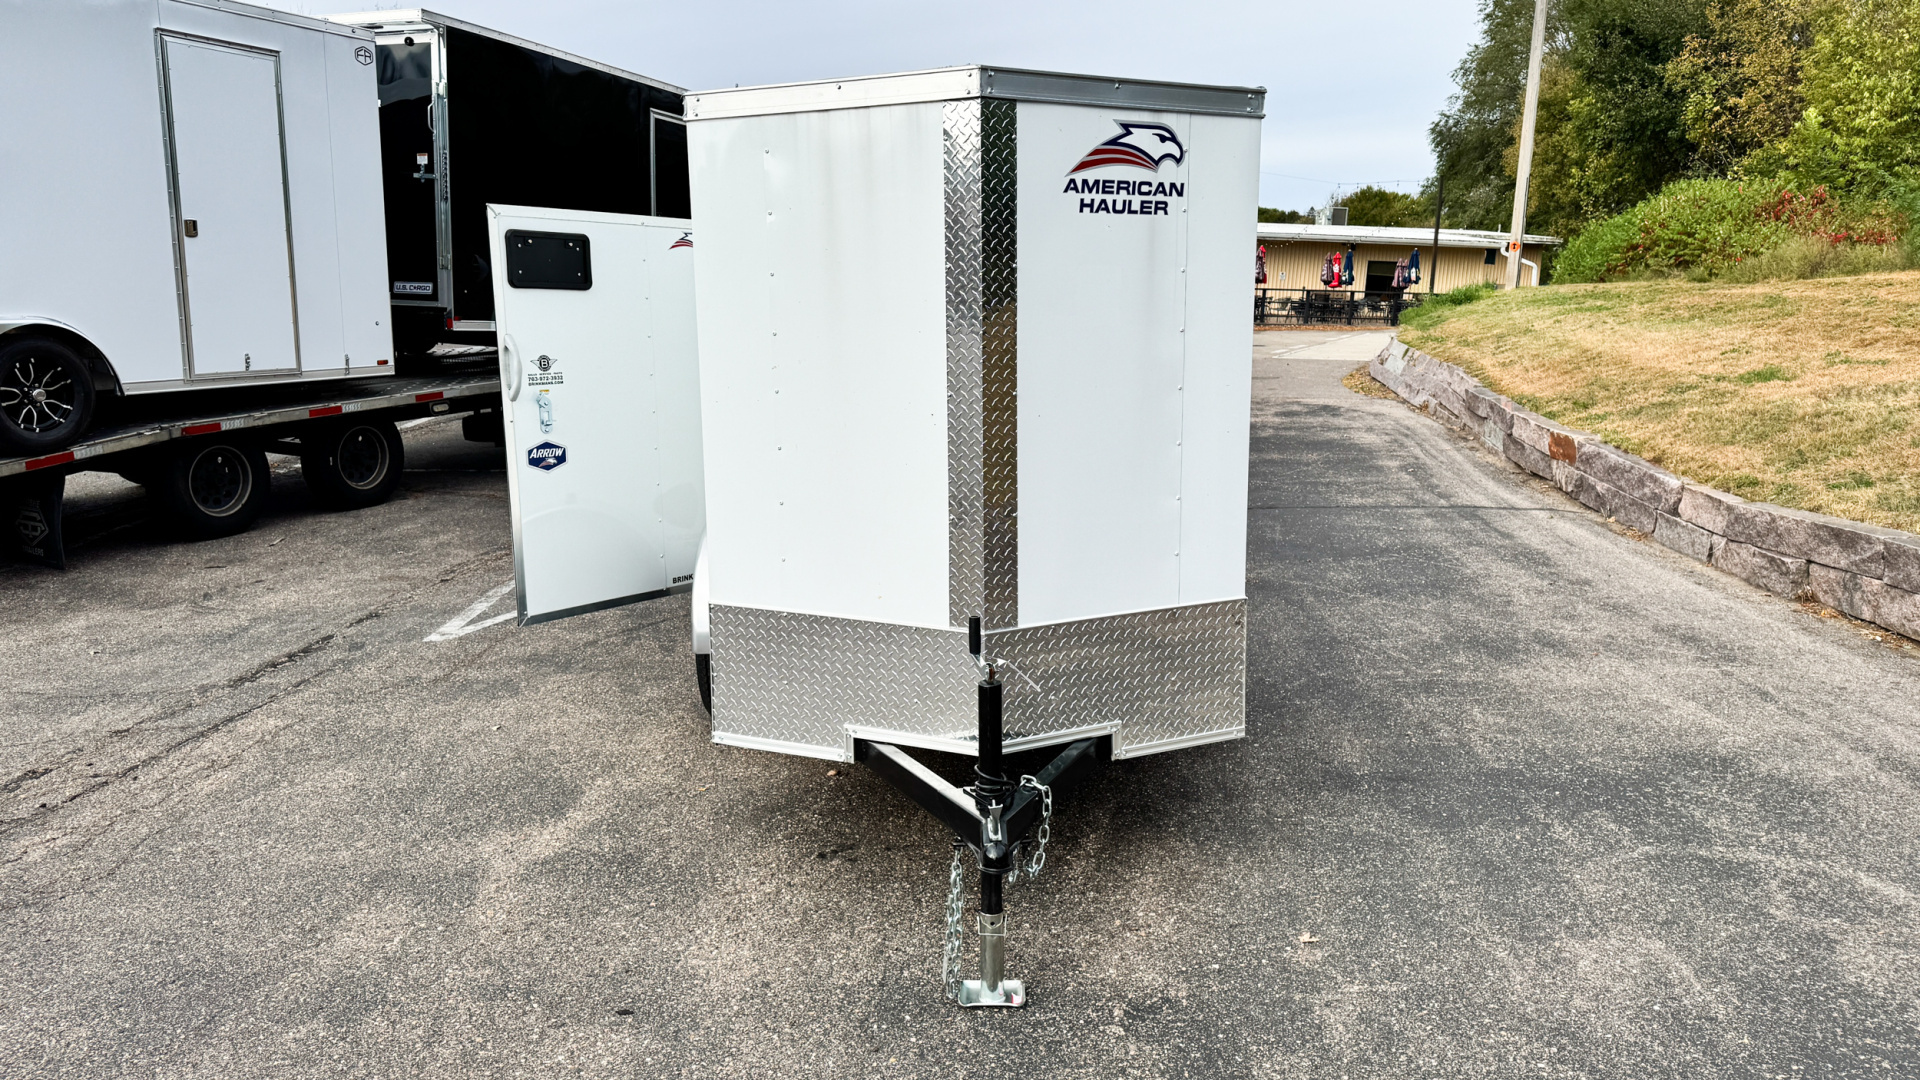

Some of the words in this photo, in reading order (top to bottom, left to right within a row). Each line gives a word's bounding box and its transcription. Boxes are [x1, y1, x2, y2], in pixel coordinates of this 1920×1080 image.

[1062, 178, 1185, 197] AMERICAN
[1079, 198, 1169, 215] HAULER
[529, 447, 565, 459] ARROW
[672, 573, 694, 585] BRINK
